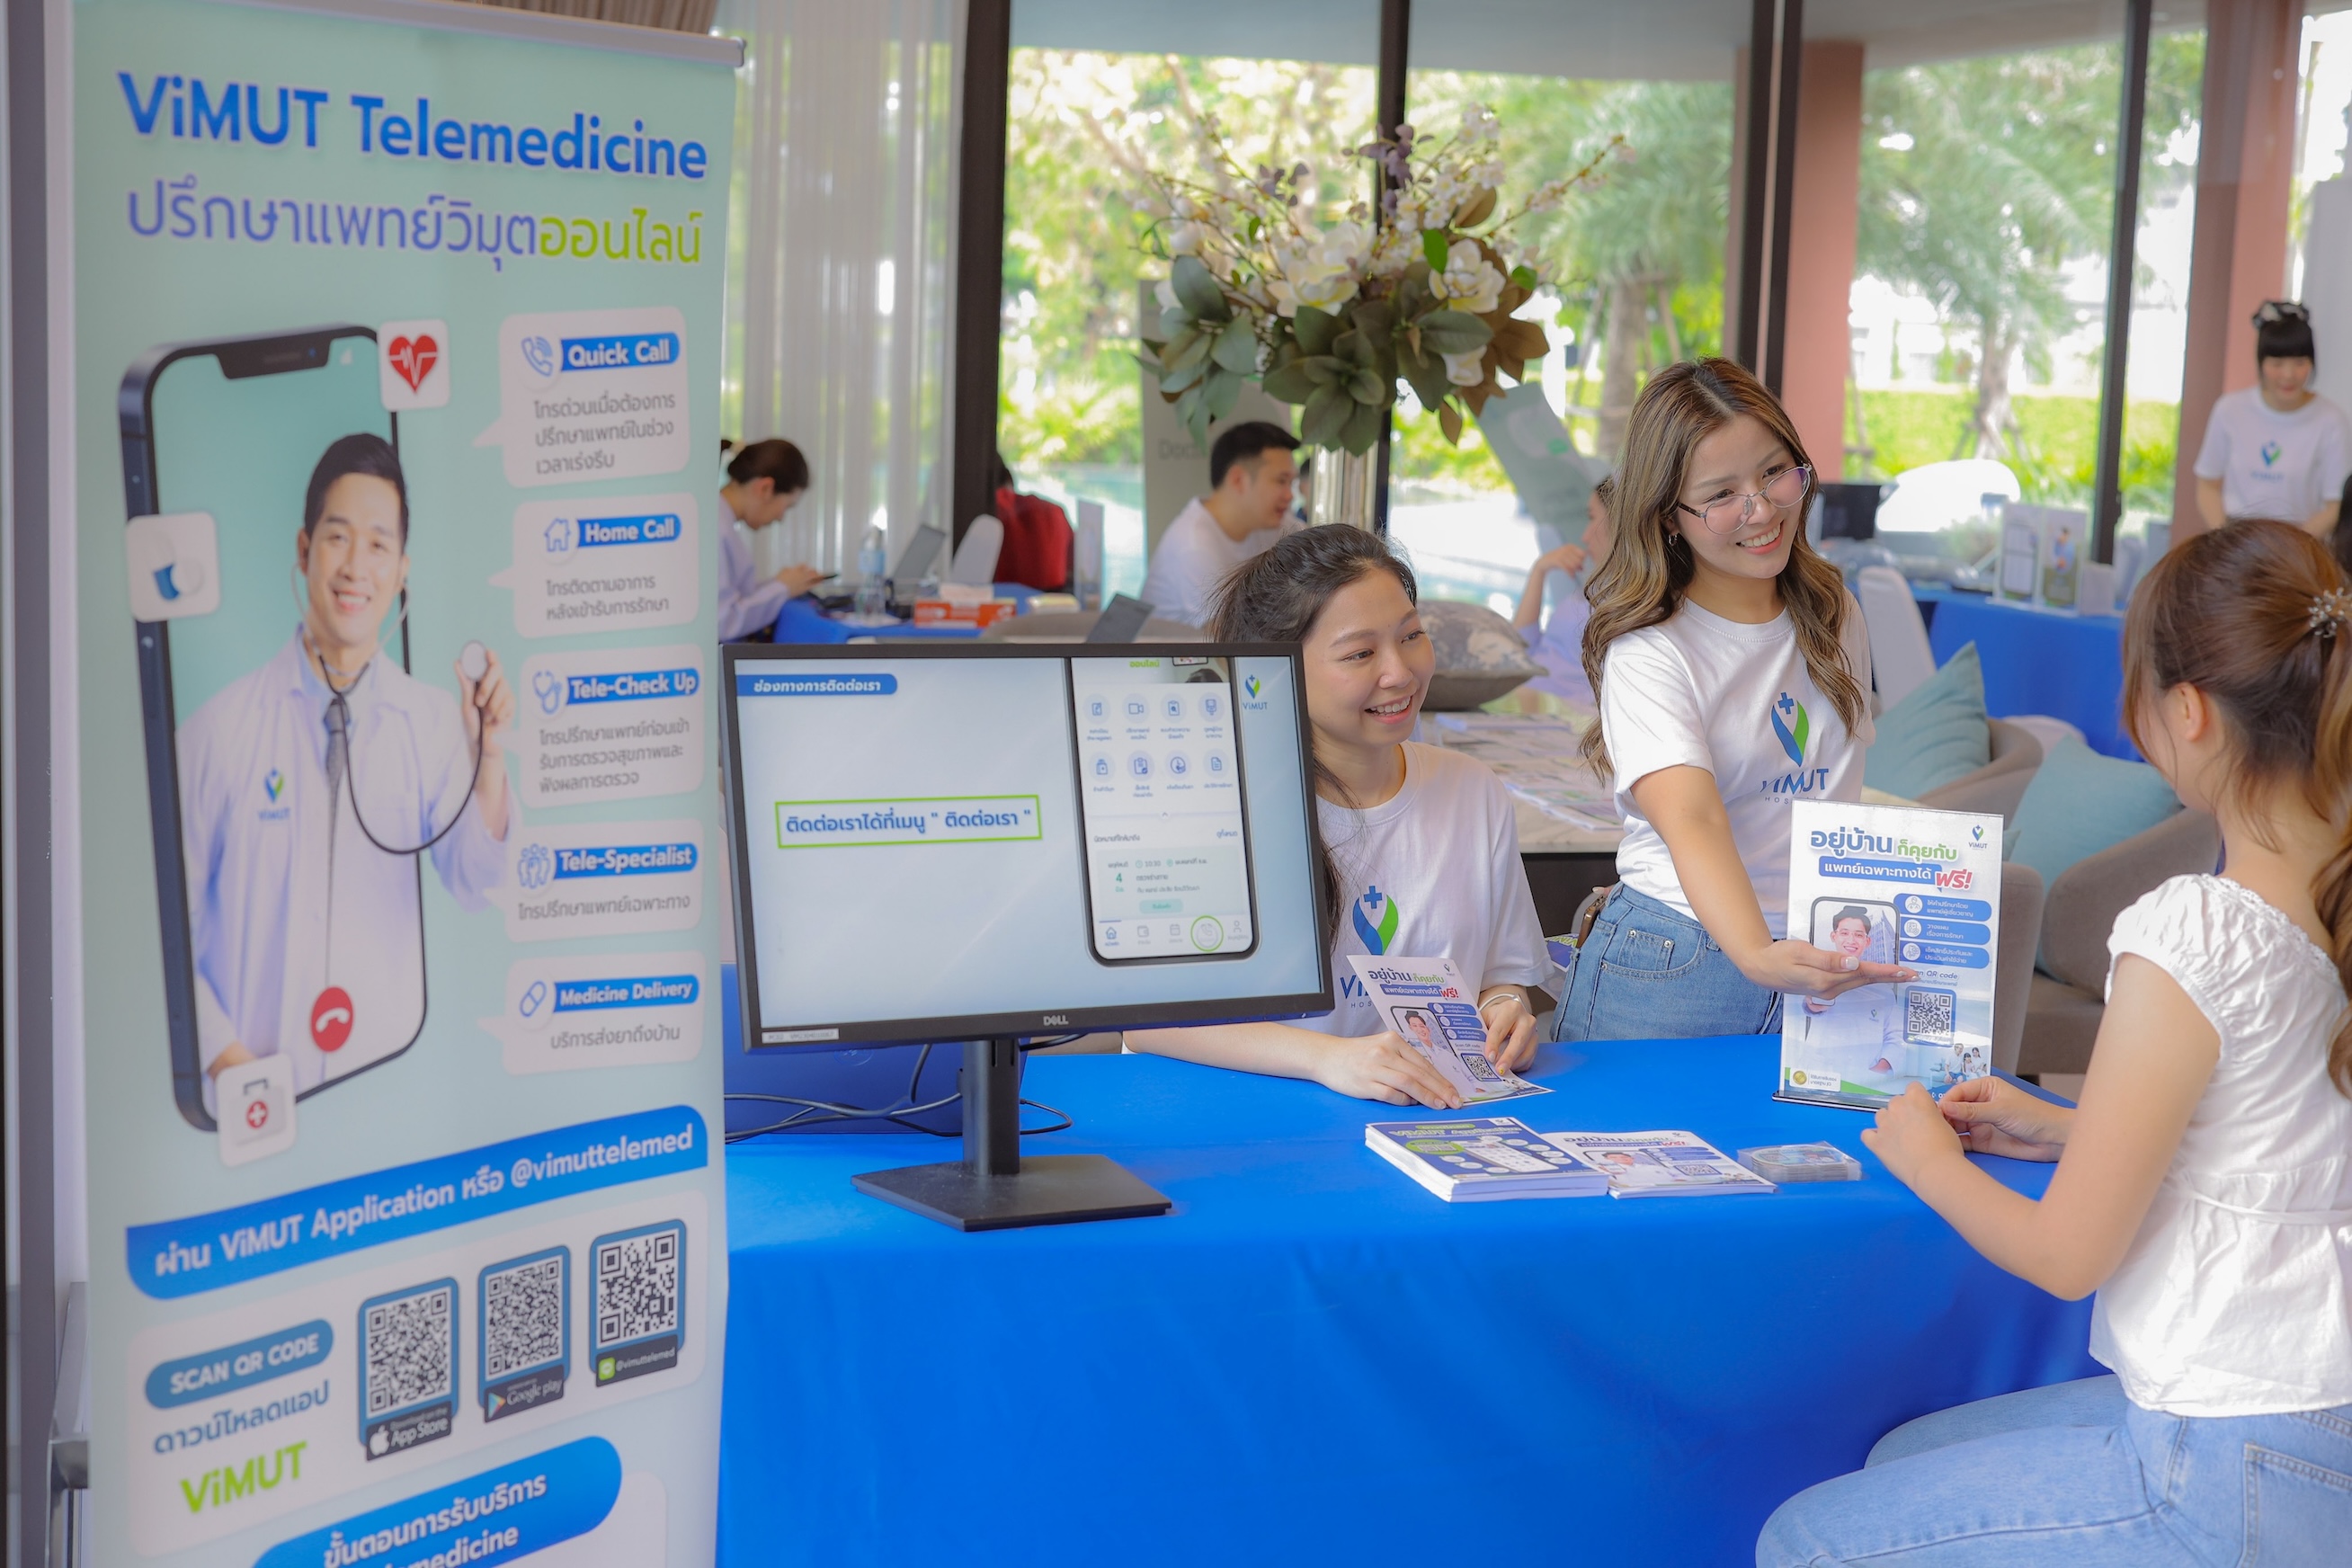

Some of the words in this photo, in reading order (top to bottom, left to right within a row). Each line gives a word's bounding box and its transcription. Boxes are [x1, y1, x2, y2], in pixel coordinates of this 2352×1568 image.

[117, 71, 329, 149] ViMUT
[350, 93, 708, 180] Telemedicine
[128, 174, 705, 272] ปรึกษาแพทย์วิมุตออนไลน์
[567, 342, 629, 368] Quick
[635, 337, 671, 364] Call
[534, 390, 676, 419] โทรด่วนเมื่อต้องการ
[535, 417, 674, 448] ปรึกษาแพทย์ในช่วง
[536, 450, 615, 475] เวลาเร่งรีบ
[585, 522, 638, 543] Home
[643, 517, 675, 539] Call
[571, 673, 669, 699] Tele-Check
[674, 673, 697, 695] Up
[753, 678, 882, 693] ช่องทางการติดต่อเรา
[786, 808, 925, 834] ติดต่อเราได้ที่เมนู
[945, 809, 1019, 828] ติดต่อเรา
[1811, 826, 1893, 857] อยู่บ้าน
[1897, 839, 1957, 862] ก็คุยกับ
[559, 846, 692, 874] Tele-Specialist
[1116, 873, 1122, 882] 4
[1825, 863, 1932, 879] แพทย์เฉพาะทางได้
[1936, 869, 1973, 889] ฟรี!
[1368, 967, 1412, 984] อยู่บ้าน
[560, 985, 628, 1007] Medicine
[632, 981, 693, 1000] Delivery
[1440, 987, 1459, 998] ฟรี!
[1043, 1015, 1069, 1026] DELL
[155, 1237, 211, 1277] ผ่าน
[220, 1213, 305, 1262] ViMUT
[311, 1183, 454, 1243] Application
[461, 1165, 504, 1201] หรือ
[510, 1124, 694, 1189] @vimuttelemed
[169, 1359, 230, 1395] SCAN
[234, 1350, 264, 1376] QR
[267, 1332, 320, 1368] CODE
[506, 1384, 541, 1405] Google
[154, 1380, 330, 1455] ดาวน์โหลดแอป
[390, 1427, 417, 1448] App
[416, 1418, 449, 1439] Store
[180, 1440, 307, 1514] ViMUT
[324, 1474, 548, 1568] ขั้นตอนการรับบริการ
[385, 1527, 519, 1568] medicine
